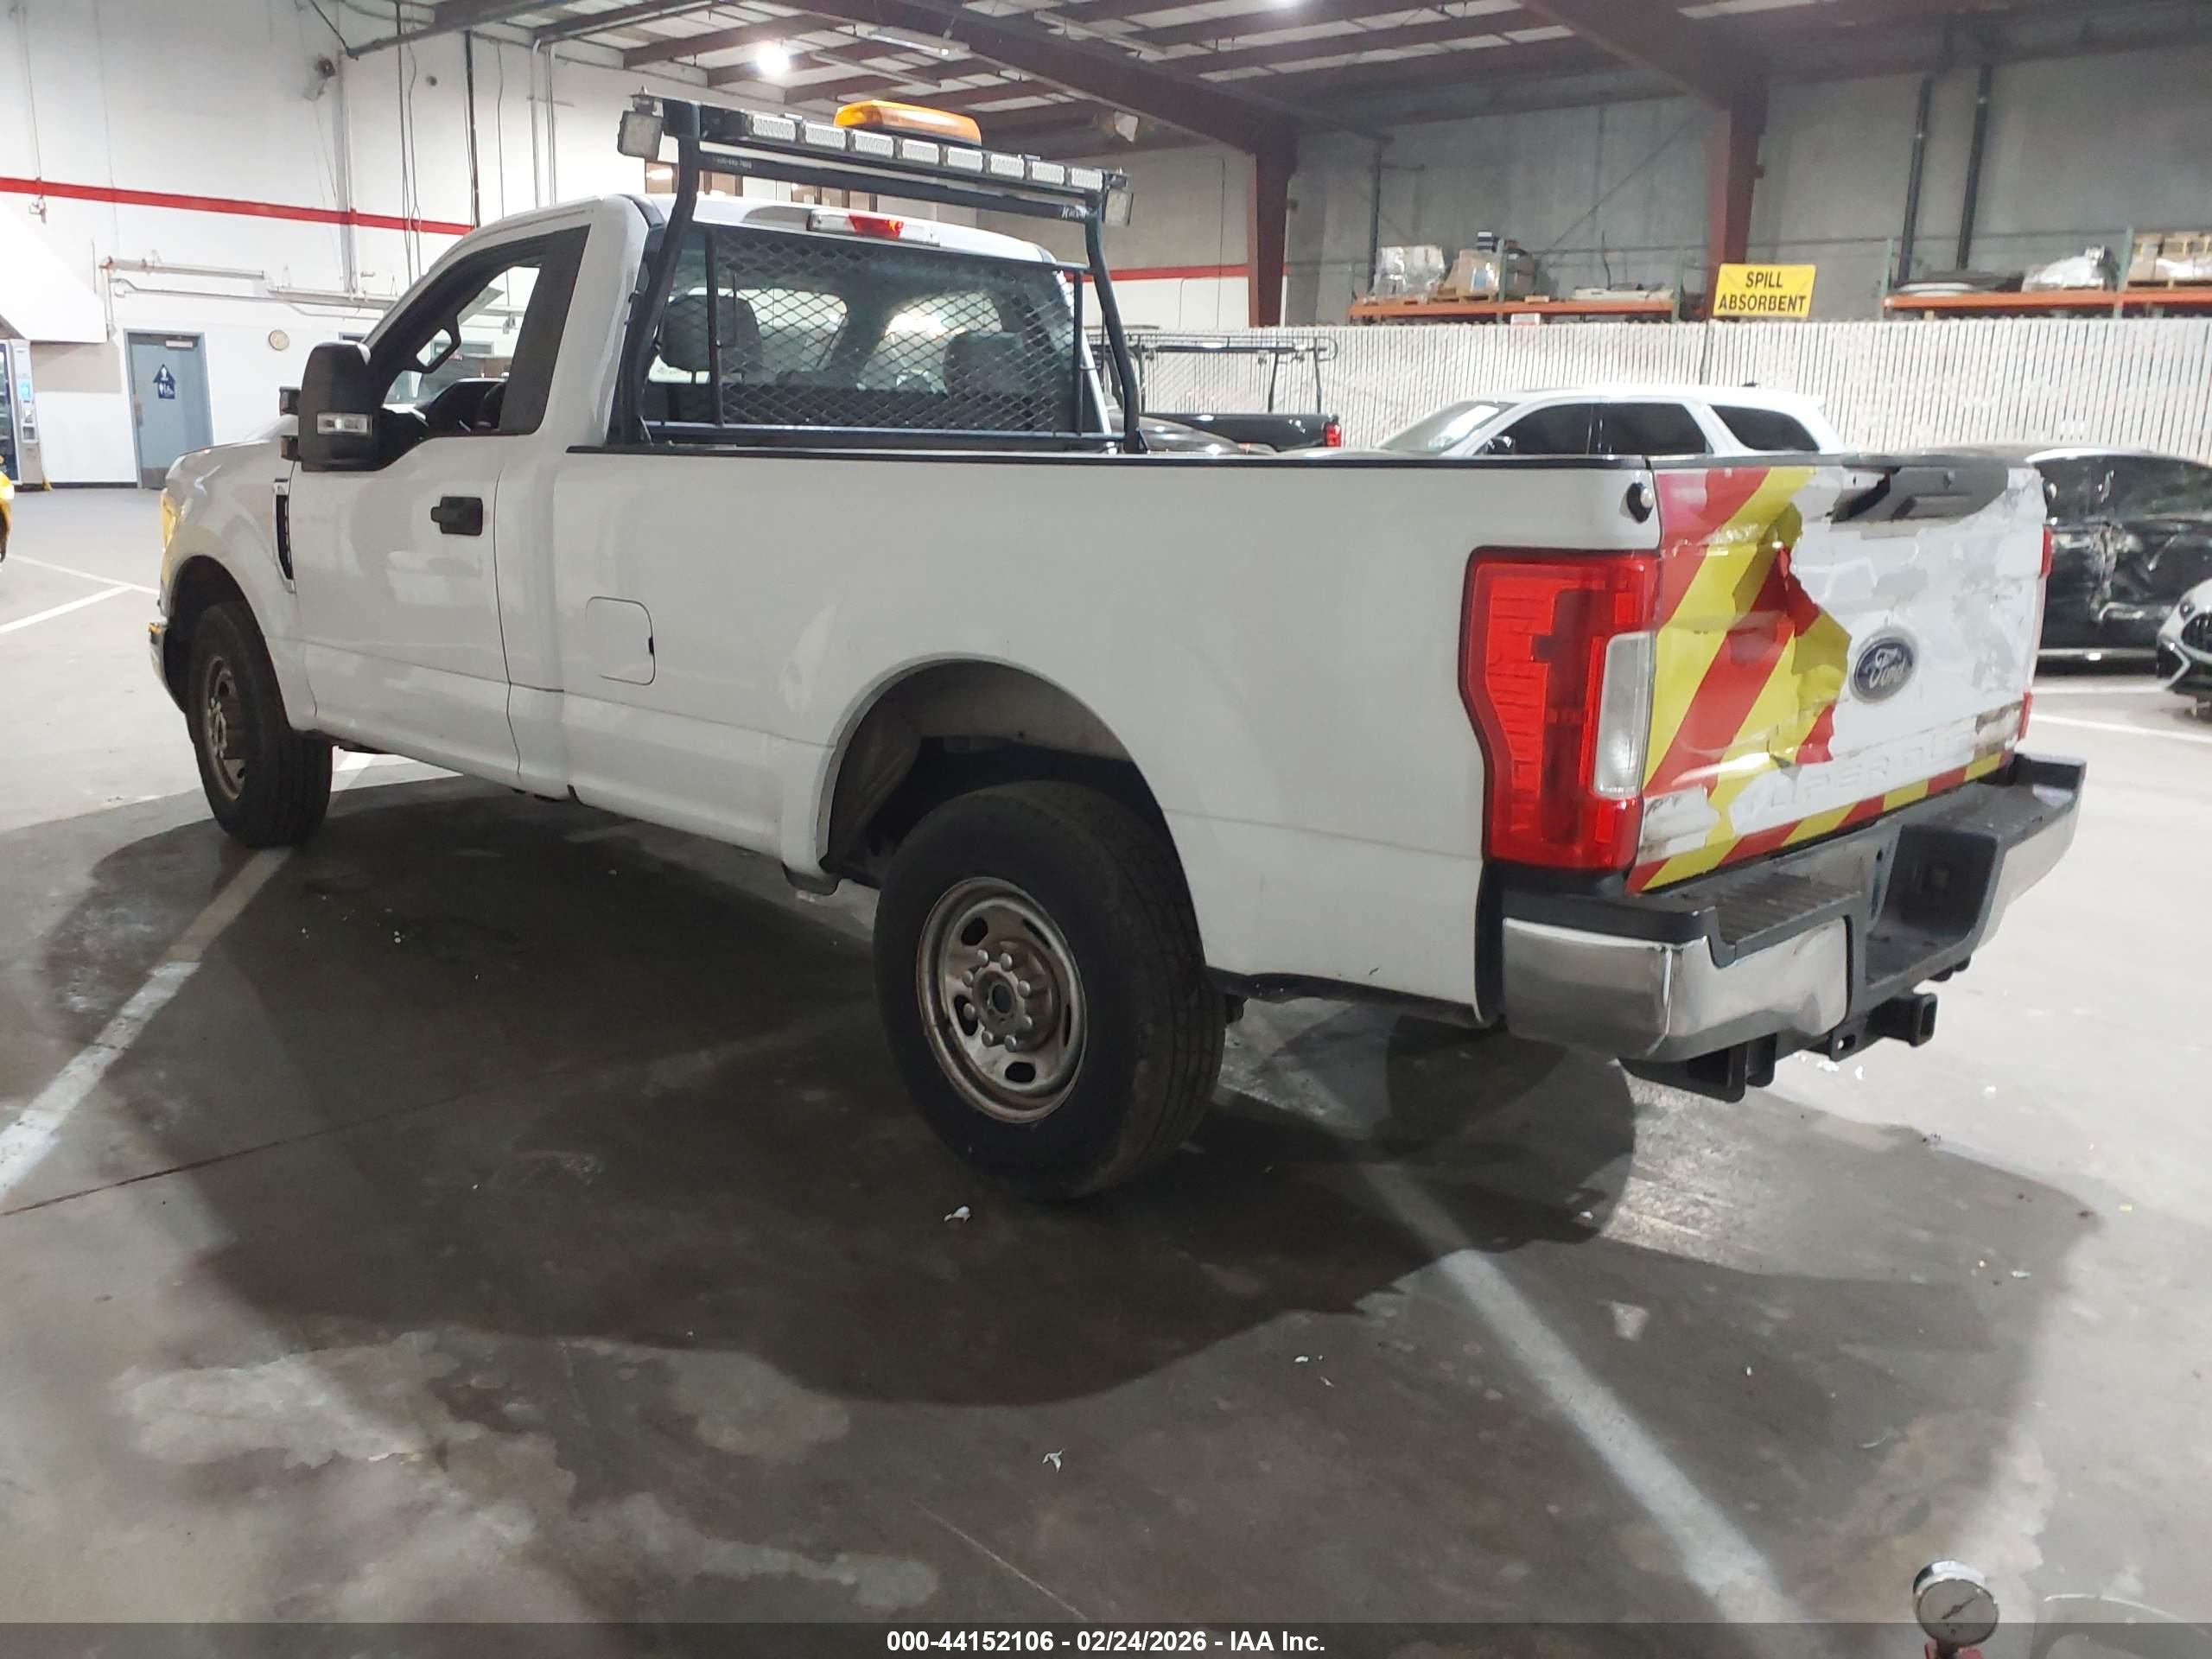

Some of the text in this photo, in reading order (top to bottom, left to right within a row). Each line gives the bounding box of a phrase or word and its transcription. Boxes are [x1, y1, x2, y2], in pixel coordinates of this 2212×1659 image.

[1745, 270, 1783, 289] SPILL
[1718, 293, 1808, 312] ABSORBENT
[1865, 646, 1909, 690] Ford
